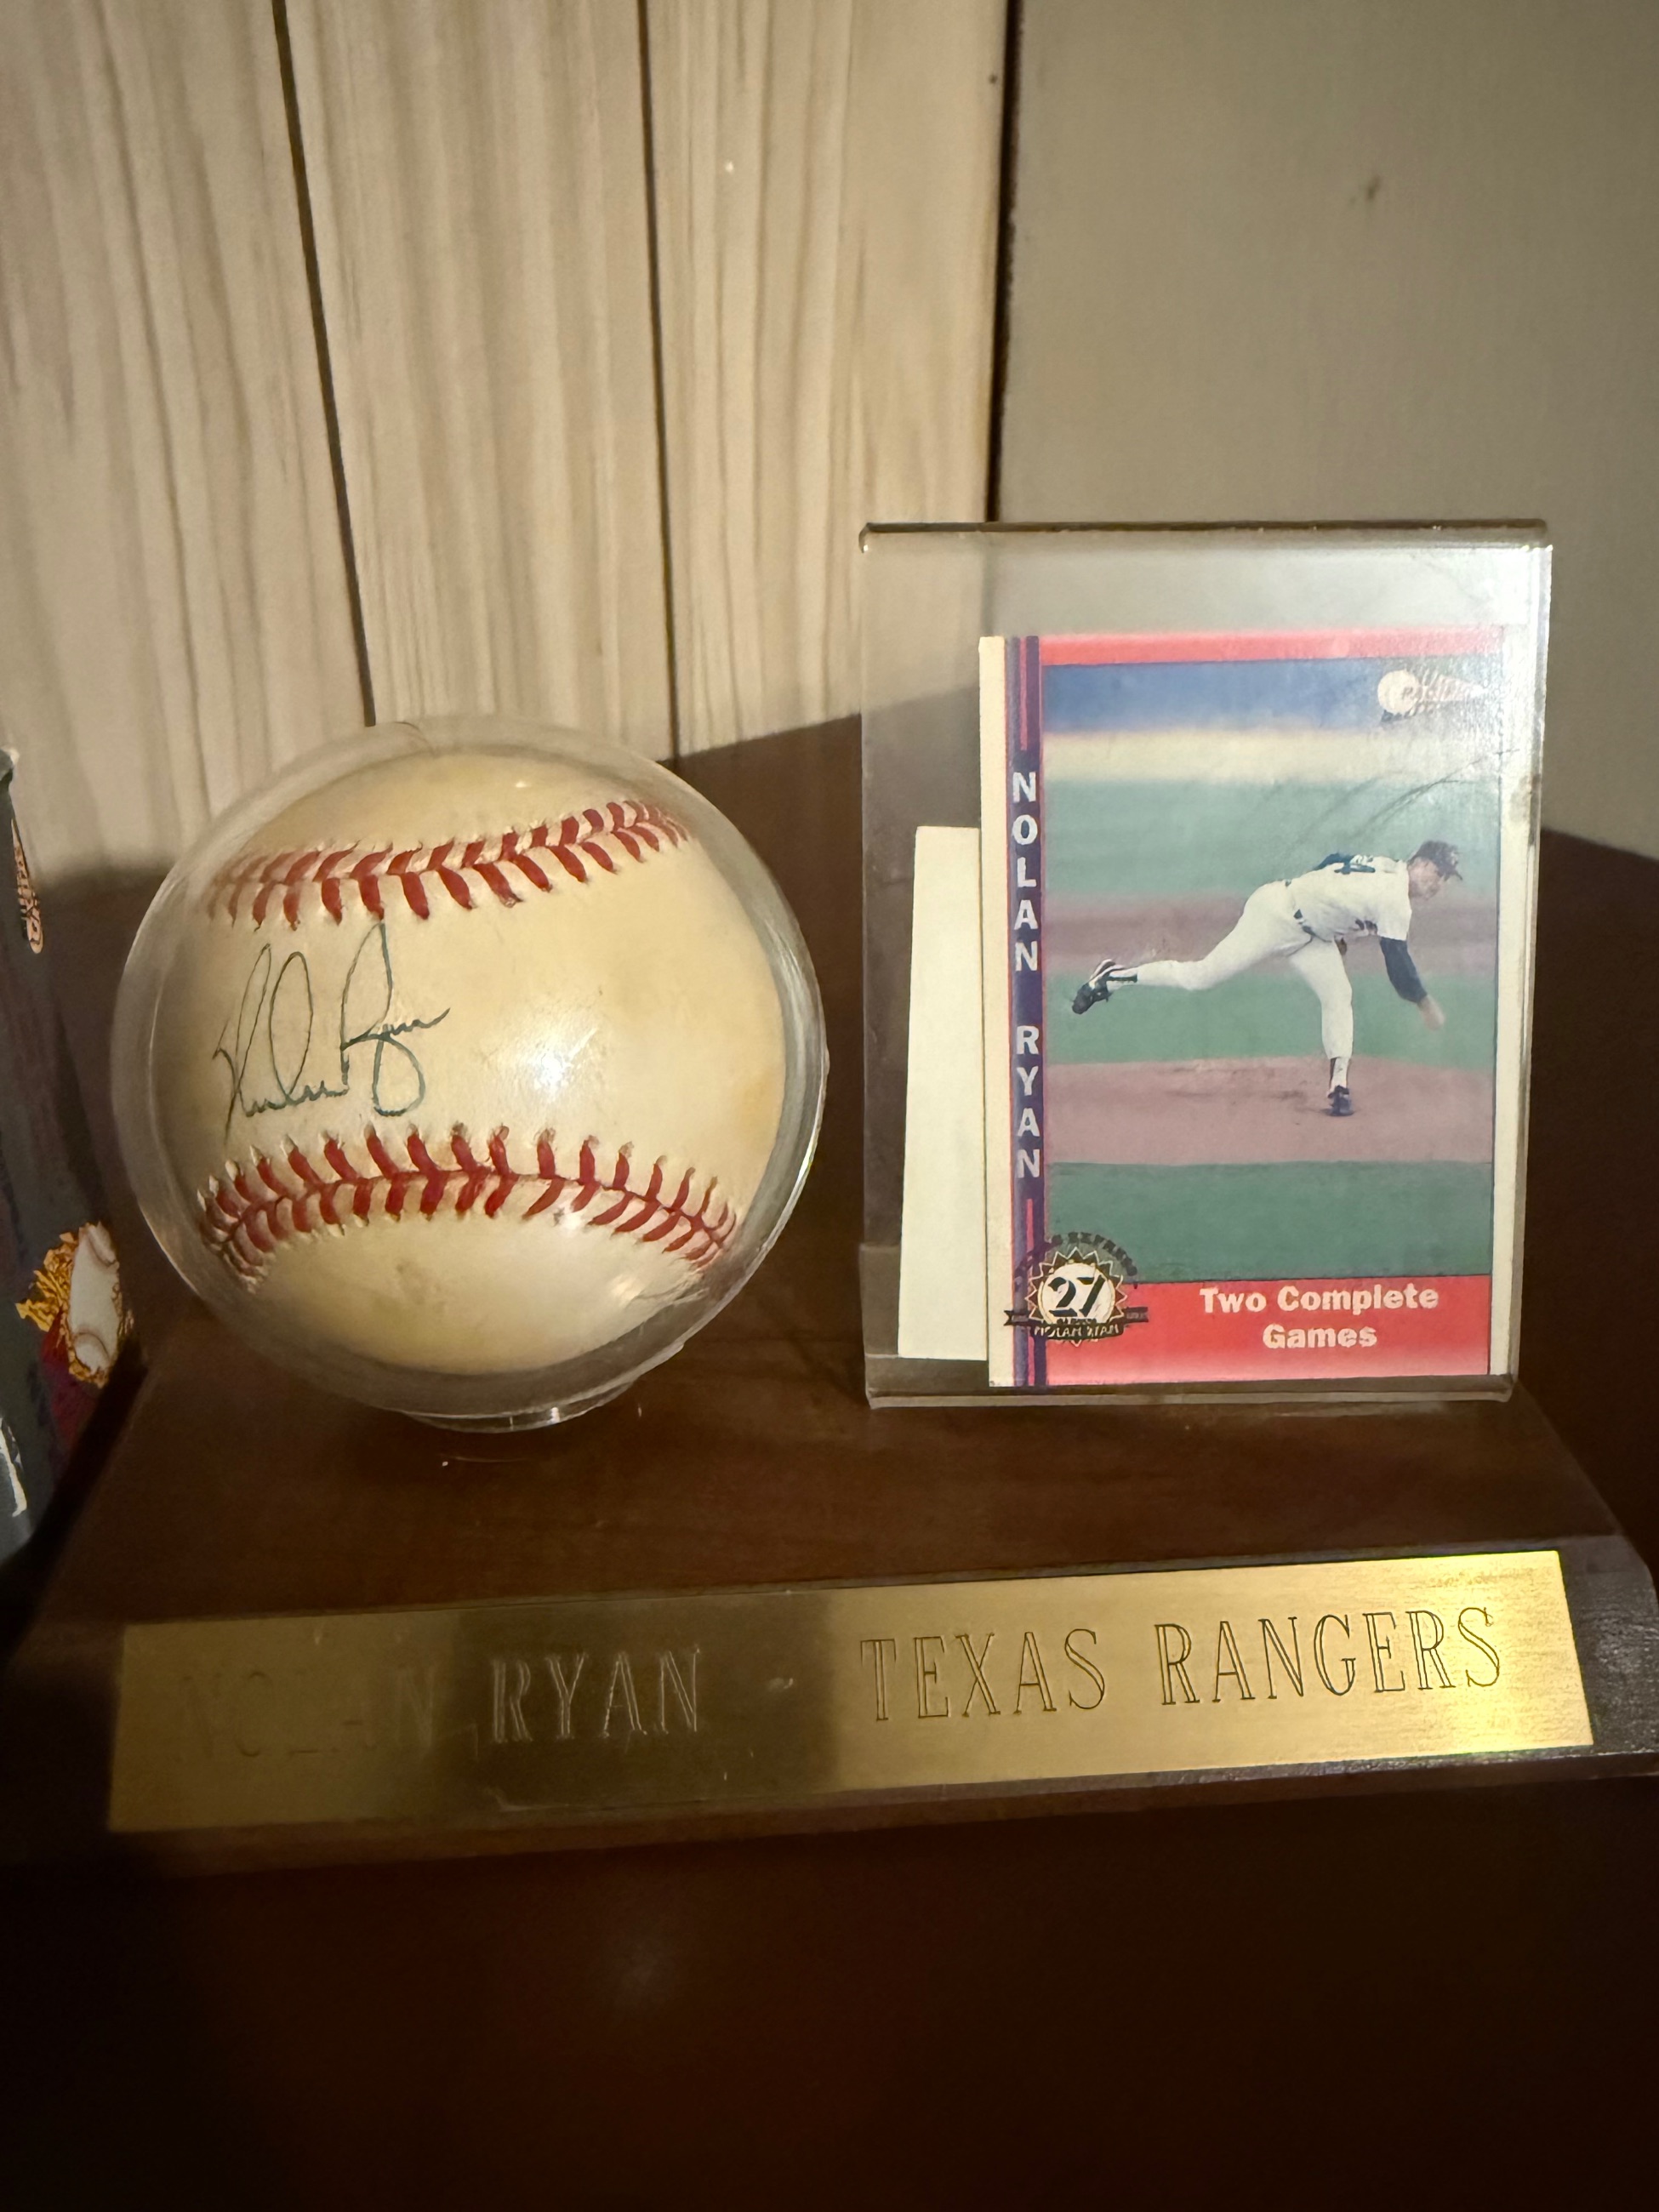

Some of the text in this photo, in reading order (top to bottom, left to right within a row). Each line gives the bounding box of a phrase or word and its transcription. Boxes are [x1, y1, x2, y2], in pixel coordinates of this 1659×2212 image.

[1011, 771, 1041, 1178] NOLAN RYAN
[1047, 1274, 1106, 1318] 27
[1199, 1282, 1440, 1315] Two Complete
[1262, 1323, 1378, 1349] Games
[490, 1642, 701, 1742] RYAN
[859, 1628, 1106, 1721] TEXAS
[1154, 1606, 1501, 1706] RANGERS
